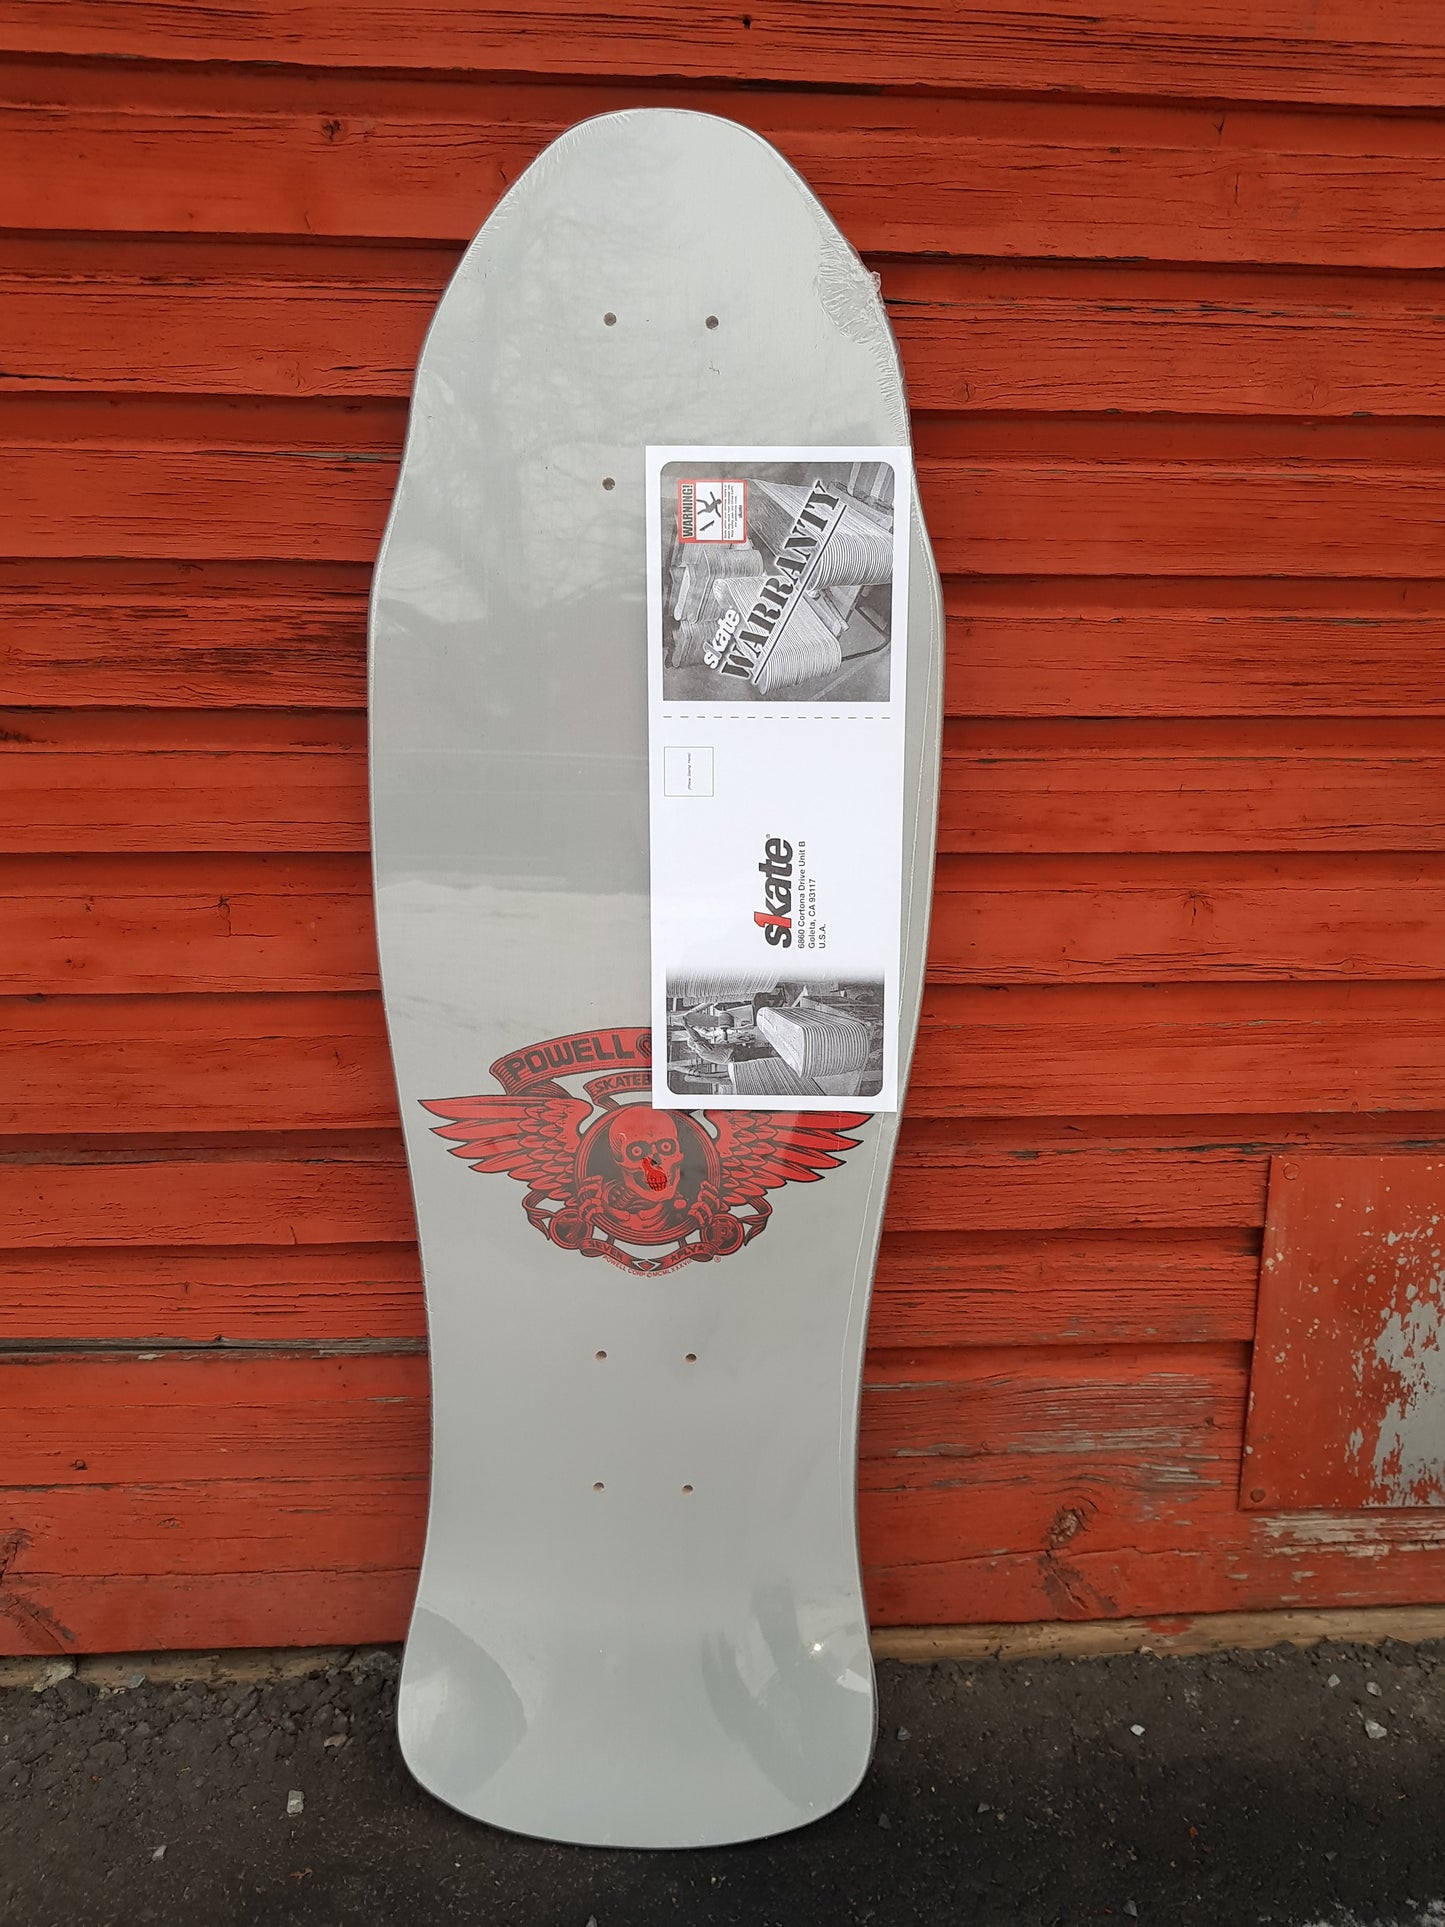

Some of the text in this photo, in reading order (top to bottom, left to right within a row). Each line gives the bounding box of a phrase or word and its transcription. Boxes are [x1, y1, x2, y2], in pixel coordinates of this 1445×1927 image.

[682, 485, 693, 537] WARNING!
[720, 480, 840, 679] WARRANTY
[797, 849, 806, 867] Unit
[797, 869, 806, 891] Drive
[797, 893, 806, 927] Cortona
[807, 878, 817, 949] Goleta, CA 93117
[797, 929, 806, 949] 6860
[818, 923, 827, 949] U.S.A.
[503, 1034, 635, 1083] POWELL
[588, 1240, 623, 1260] SEVEN
[602, 1255, 626, 1272] POWELL
